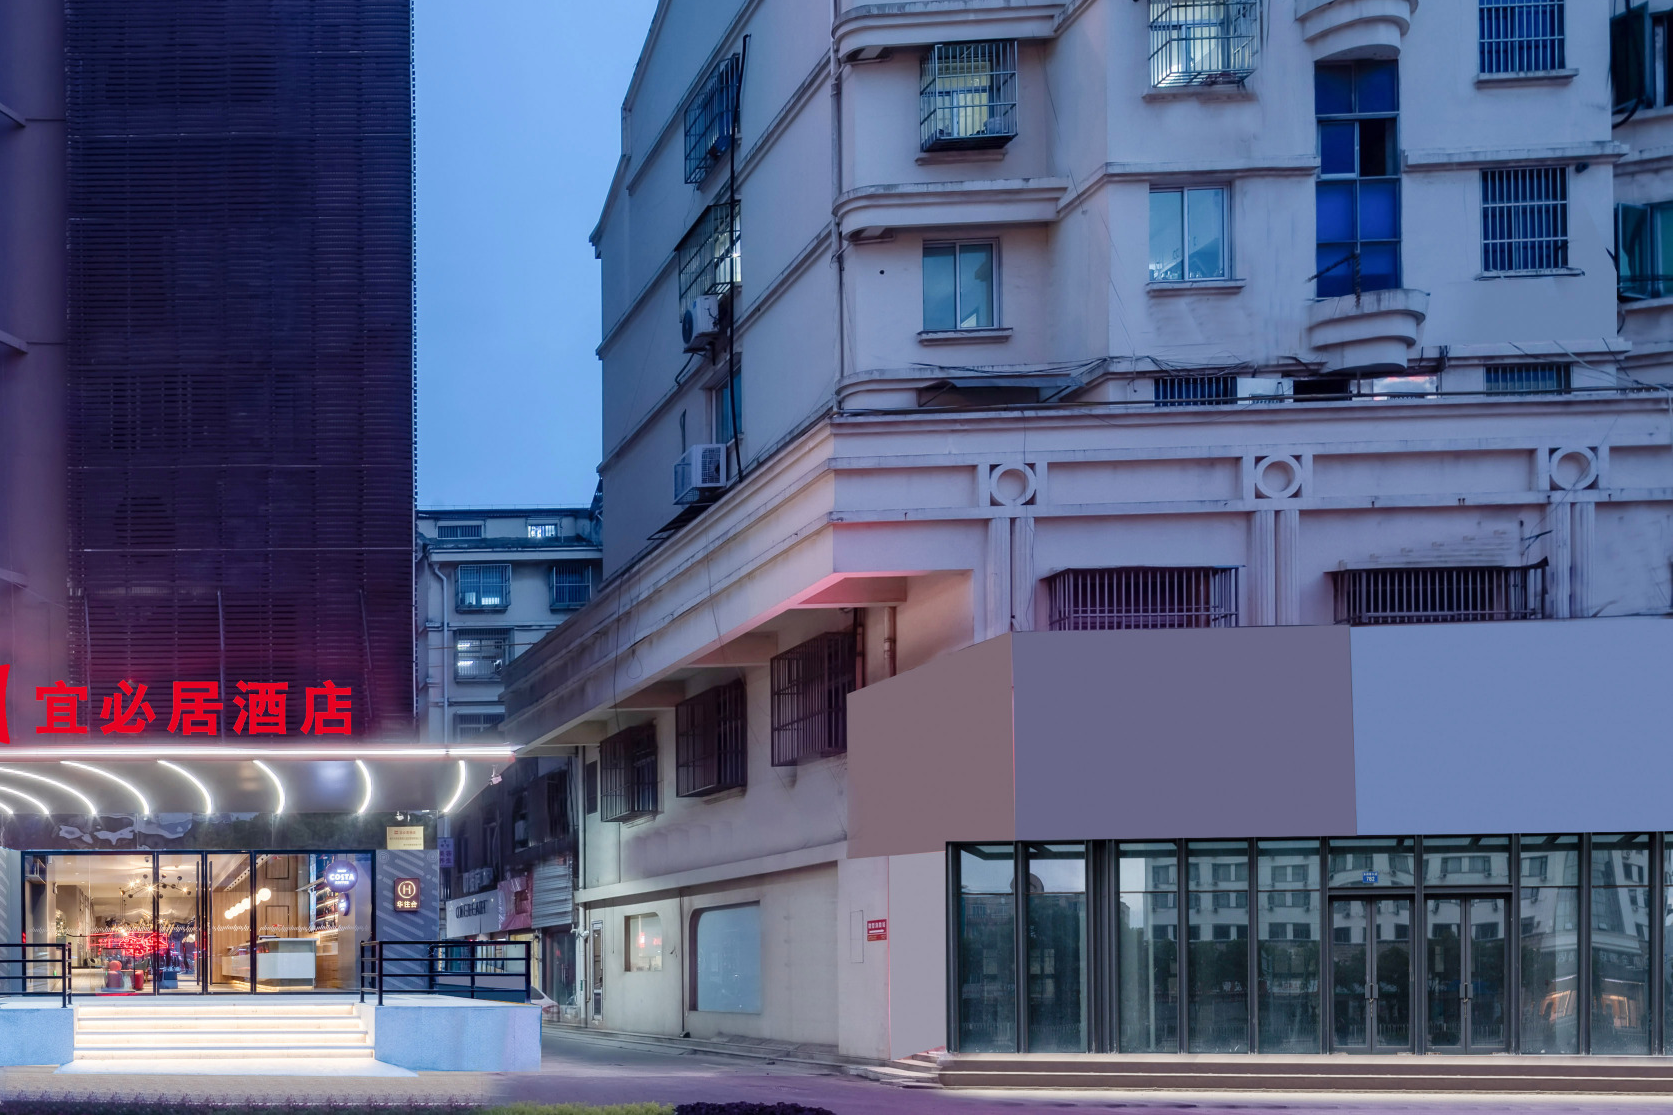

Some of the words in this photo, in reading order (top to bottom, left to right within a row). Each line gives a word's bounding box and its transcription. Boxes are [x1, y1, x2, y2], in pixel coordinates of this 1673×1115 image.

[35, 679, 353, 736] 宜必居酒店
[329, 873, 355, 881] COSTA
[396, 900, 418, 909] 华住会
